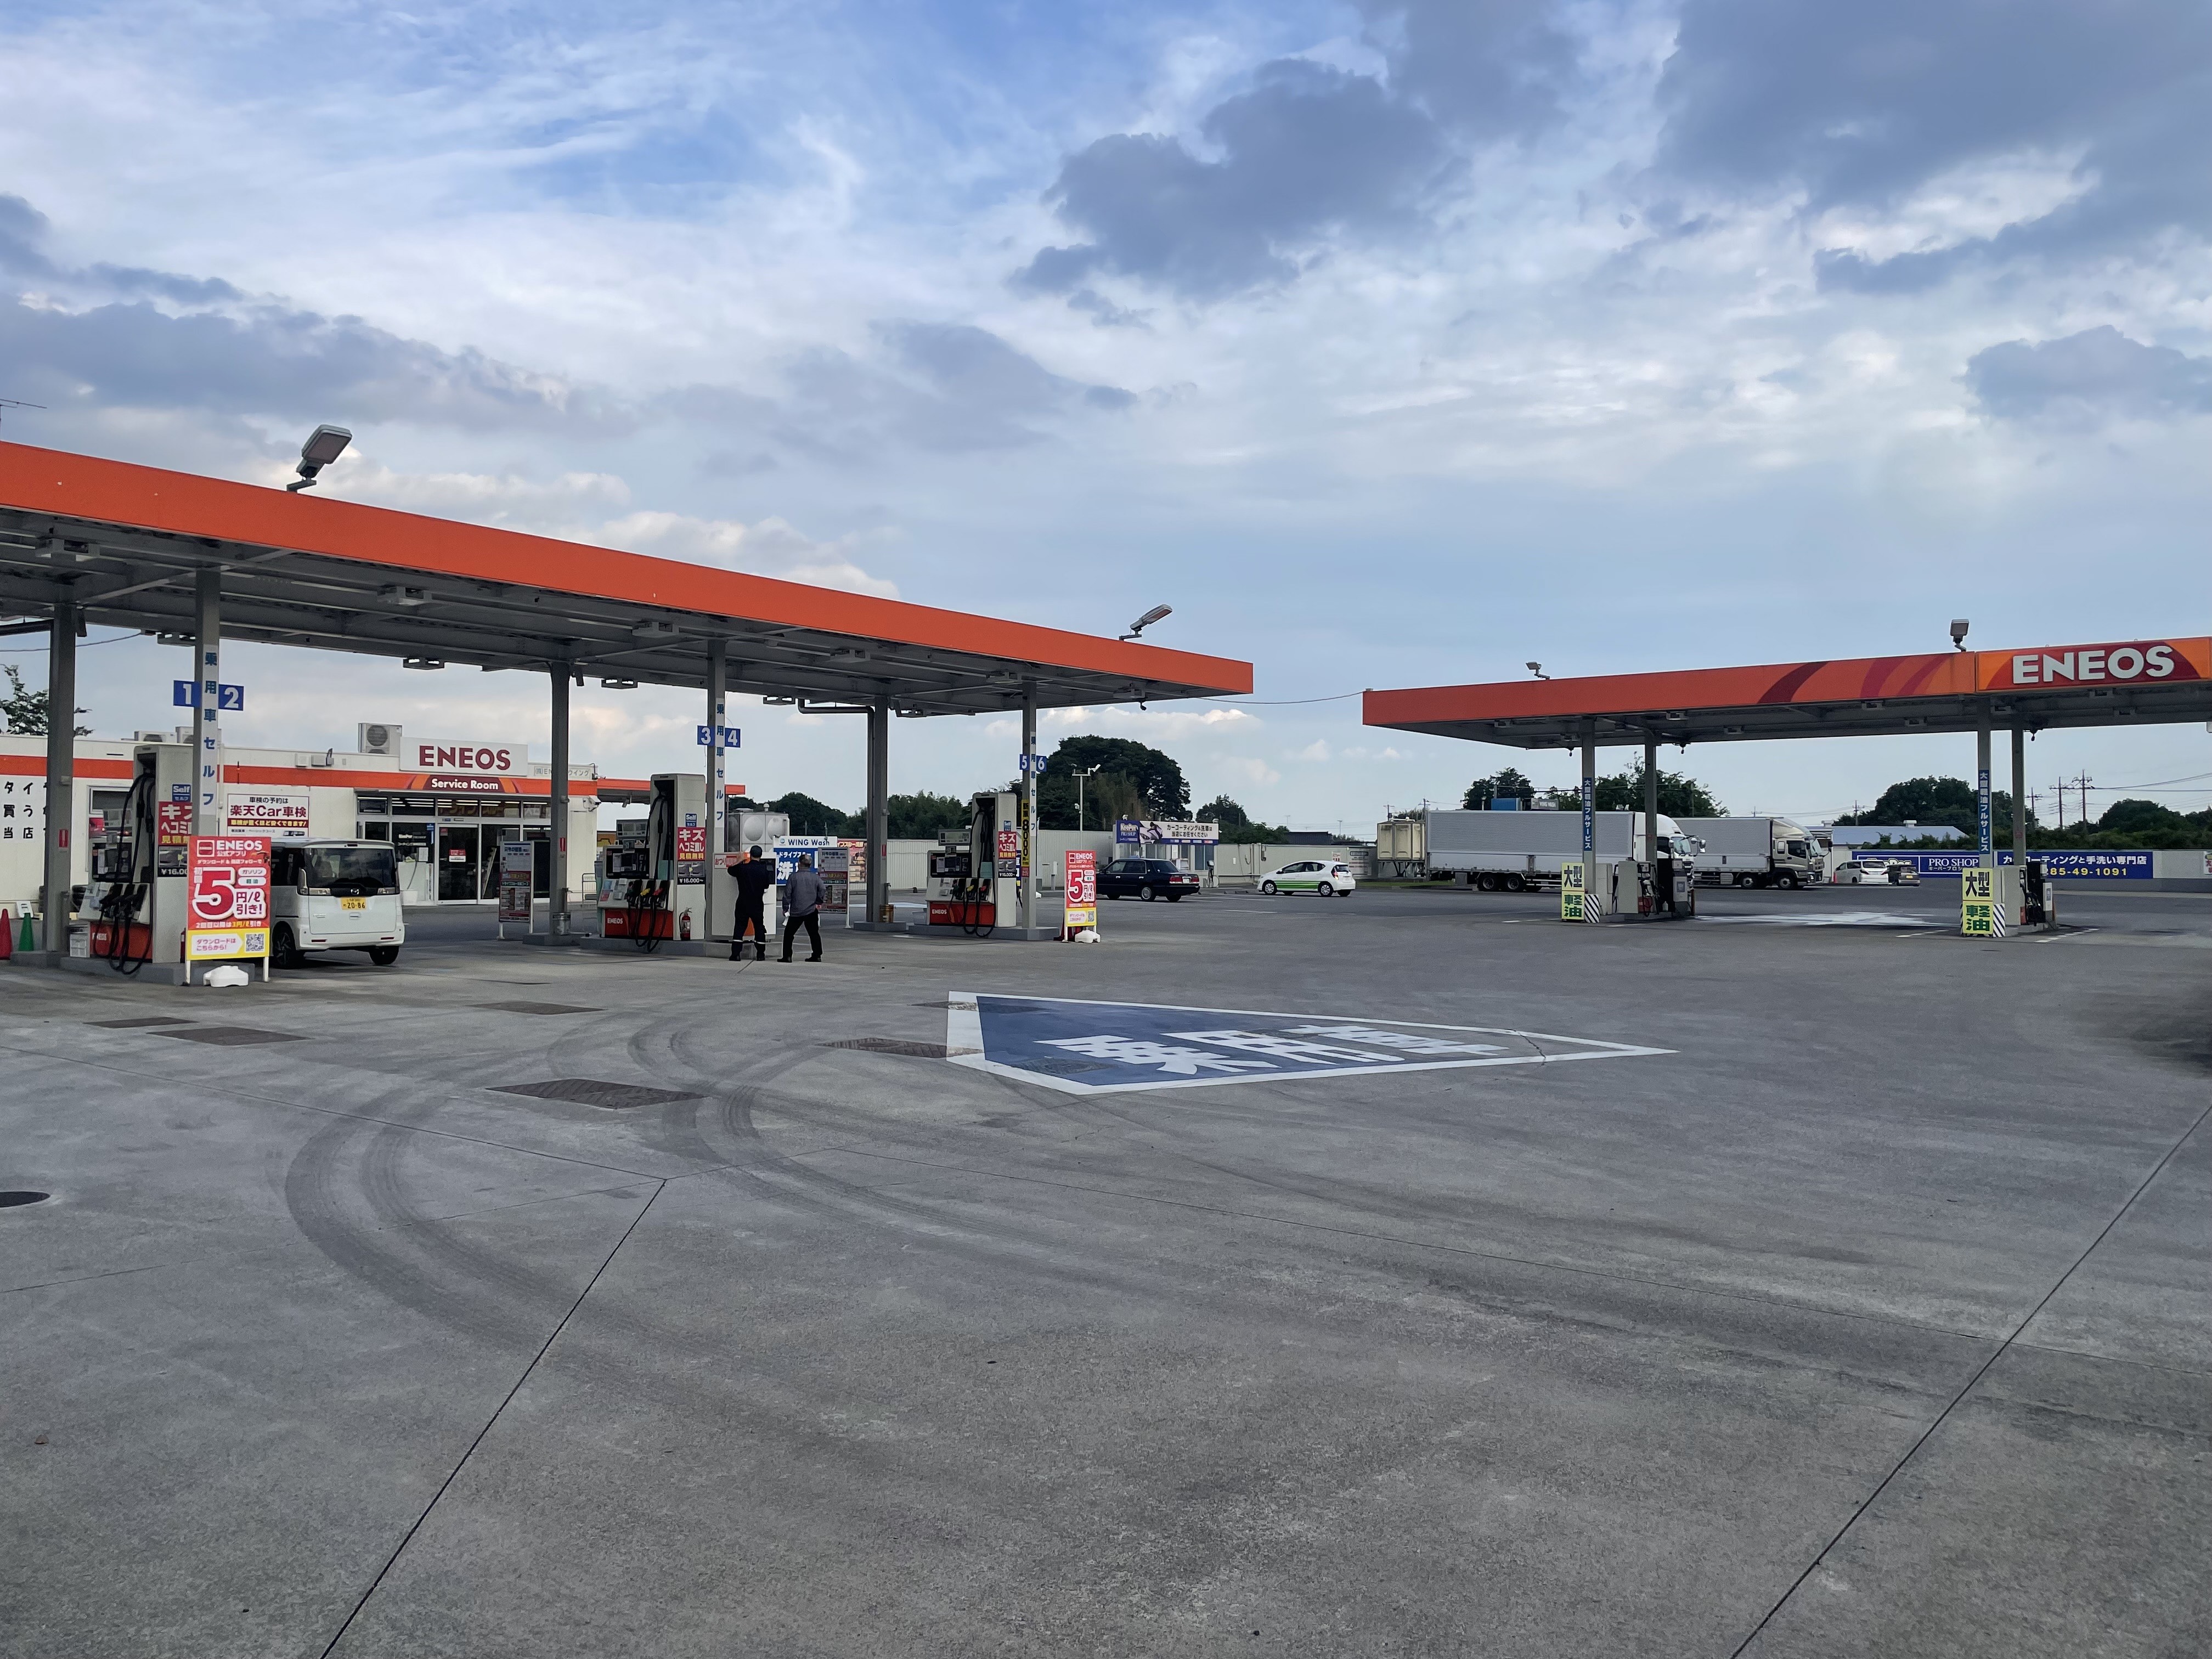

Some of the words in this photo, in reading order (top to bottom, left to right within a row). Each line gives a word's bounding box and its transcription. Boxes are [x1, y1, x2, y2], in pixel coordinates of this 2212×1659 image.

[2013, 645, 2175, 684] ENEOS
[183, 684, 191, 705] 1
[224, 687, 239, 708] 2
[203, 652, 217, 805] 乗用車セルフ
[701, 727, 711, 744] 3
[727, 730, 738, 746] 4
[419, 745, 511, 770] ENEOS
[1022, 755, 1028, 769] 5
[1037, 757, 1045, 770] 6
[4, 781, 47, 795] タイ
[431, 778, 469, 789] Service
[471, 780, 499, 790] Room
[3, 804, 47, 817] 買う
[230, 805, 307, 817] 楽天Car車検
[3, 827, 46, 839] 当店
[161, 821, 192, 834] ヘコミ
[679, 829, 704, 841] キズ
[216, 840, 263, 851] ENEOS
[999, 833, 1016, 843] キズ
[1928, 858, 1949, 866] PRO
[1951, 858, 1979, 866] SHOP
[2003, 855, 2147, 865] カーティングと手洗い専門店
[1564, 865, 1582, 888] 大型
[2047, 867, 2128, 876] 85-49-1091
[1068, 869, 1084, 902] 5
[1966, 871, 1990, 897] 大型
[192, 867, 236, 921] 5
[1564, 894, 1582, 917] 軽油
[1966, 905, 1990, 932] 軽油
[1033, 1024, 1510, 1075] 乗用車
